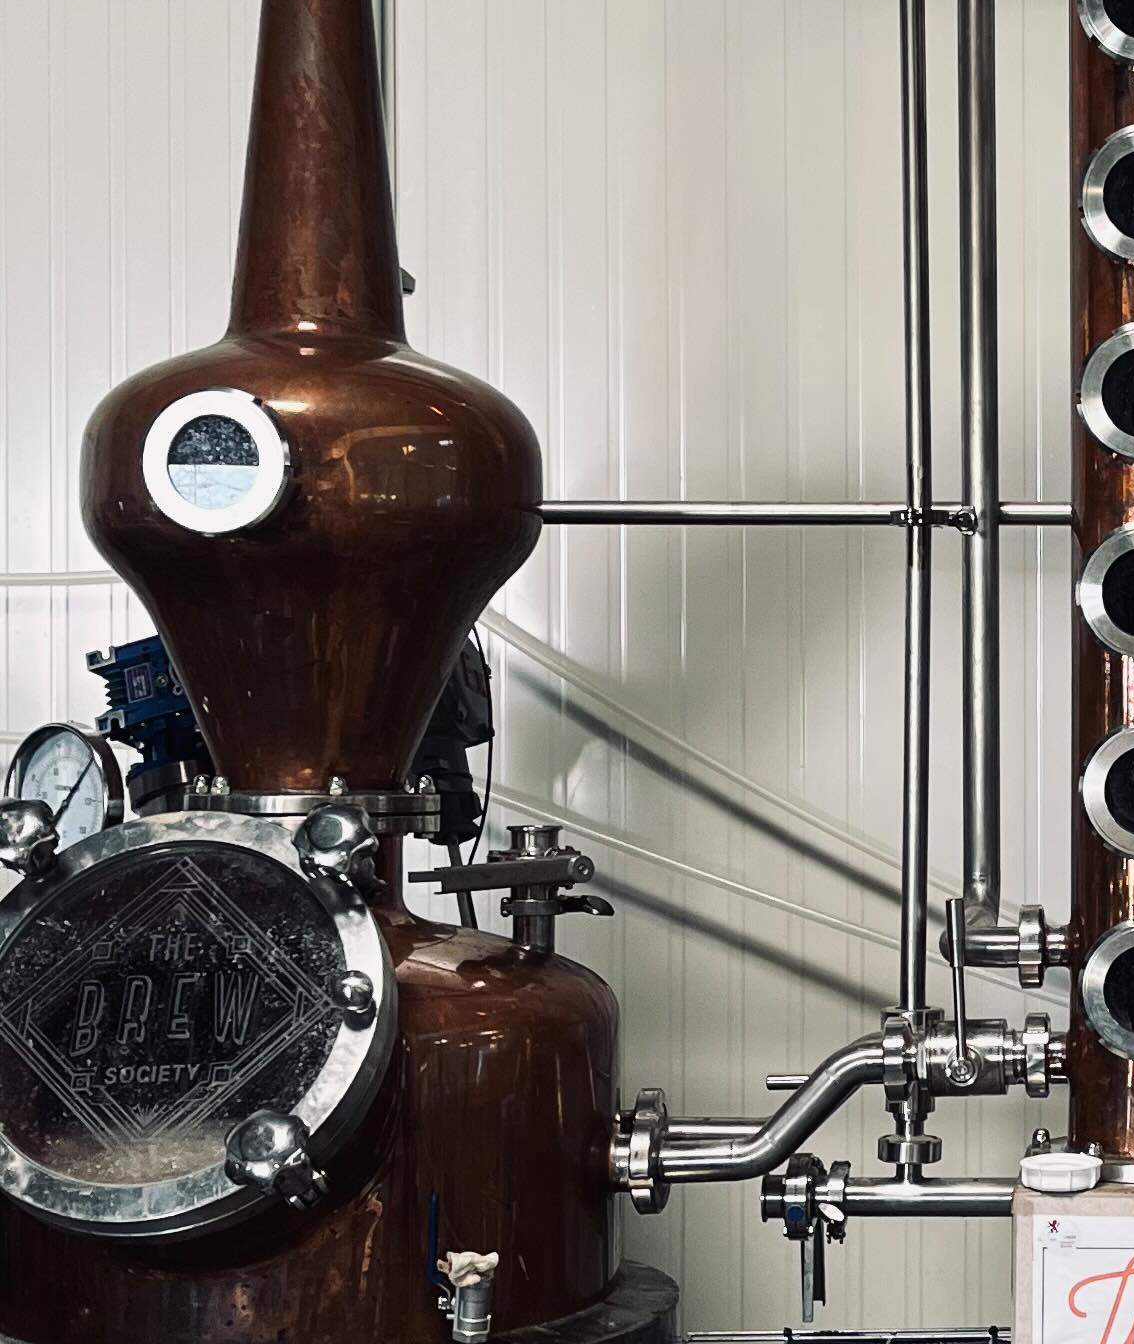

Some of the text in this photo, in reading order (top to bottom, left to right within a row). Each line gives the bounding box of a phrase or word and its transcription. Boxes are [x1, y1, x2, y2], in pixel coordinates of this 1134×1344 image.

[149, 933, 198, 961] THE
[70, 971, 260, 1056] BREW
[103, 1063, 201, 1085] SOCIETY
